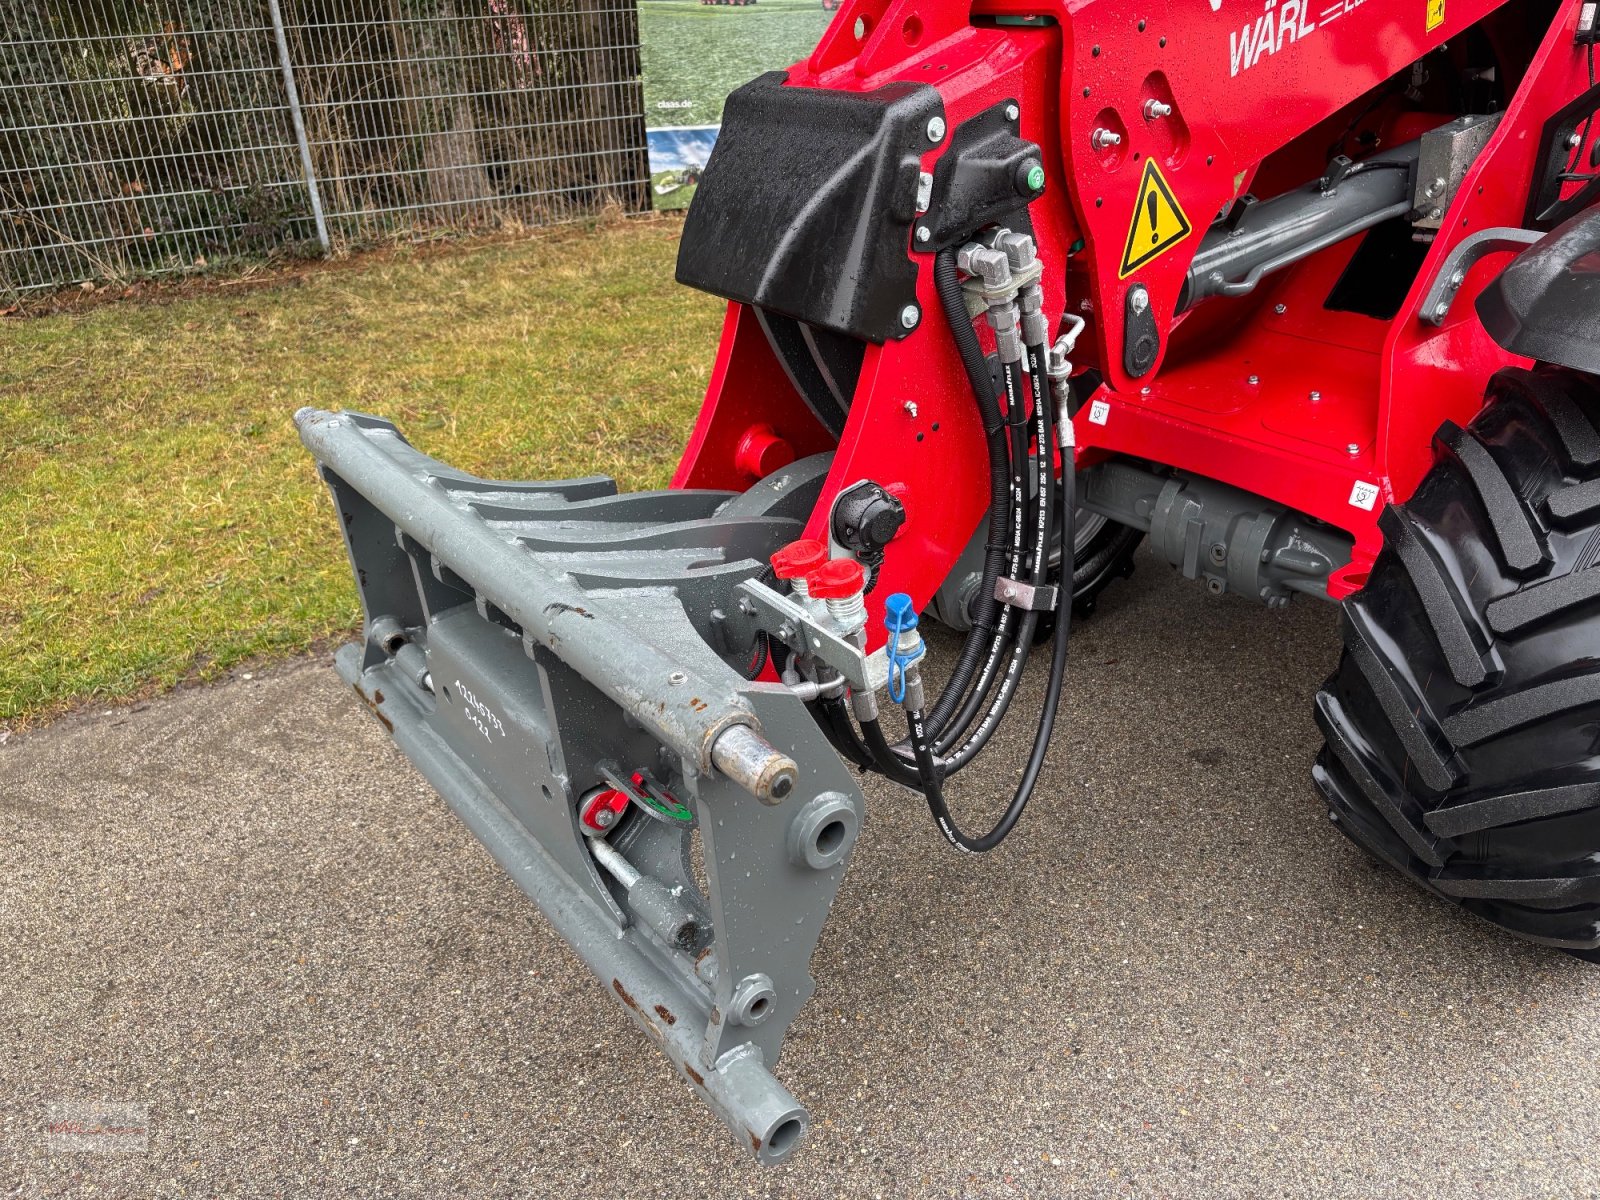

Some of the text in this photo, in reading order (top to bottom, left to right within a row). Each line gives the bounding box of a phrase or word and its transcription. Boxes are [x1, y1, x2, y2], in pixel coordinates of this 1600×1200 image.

[1230, 0, 1315, 78] WÄRL
[657, 99, 693, 109] claas.de
[1035, 398, 1043, 416] MSHA
[1037, 419, 1045, 433] BAR
[1039, 444, 1046, 455] WP
[1039, 498, 1046, 507] EN
